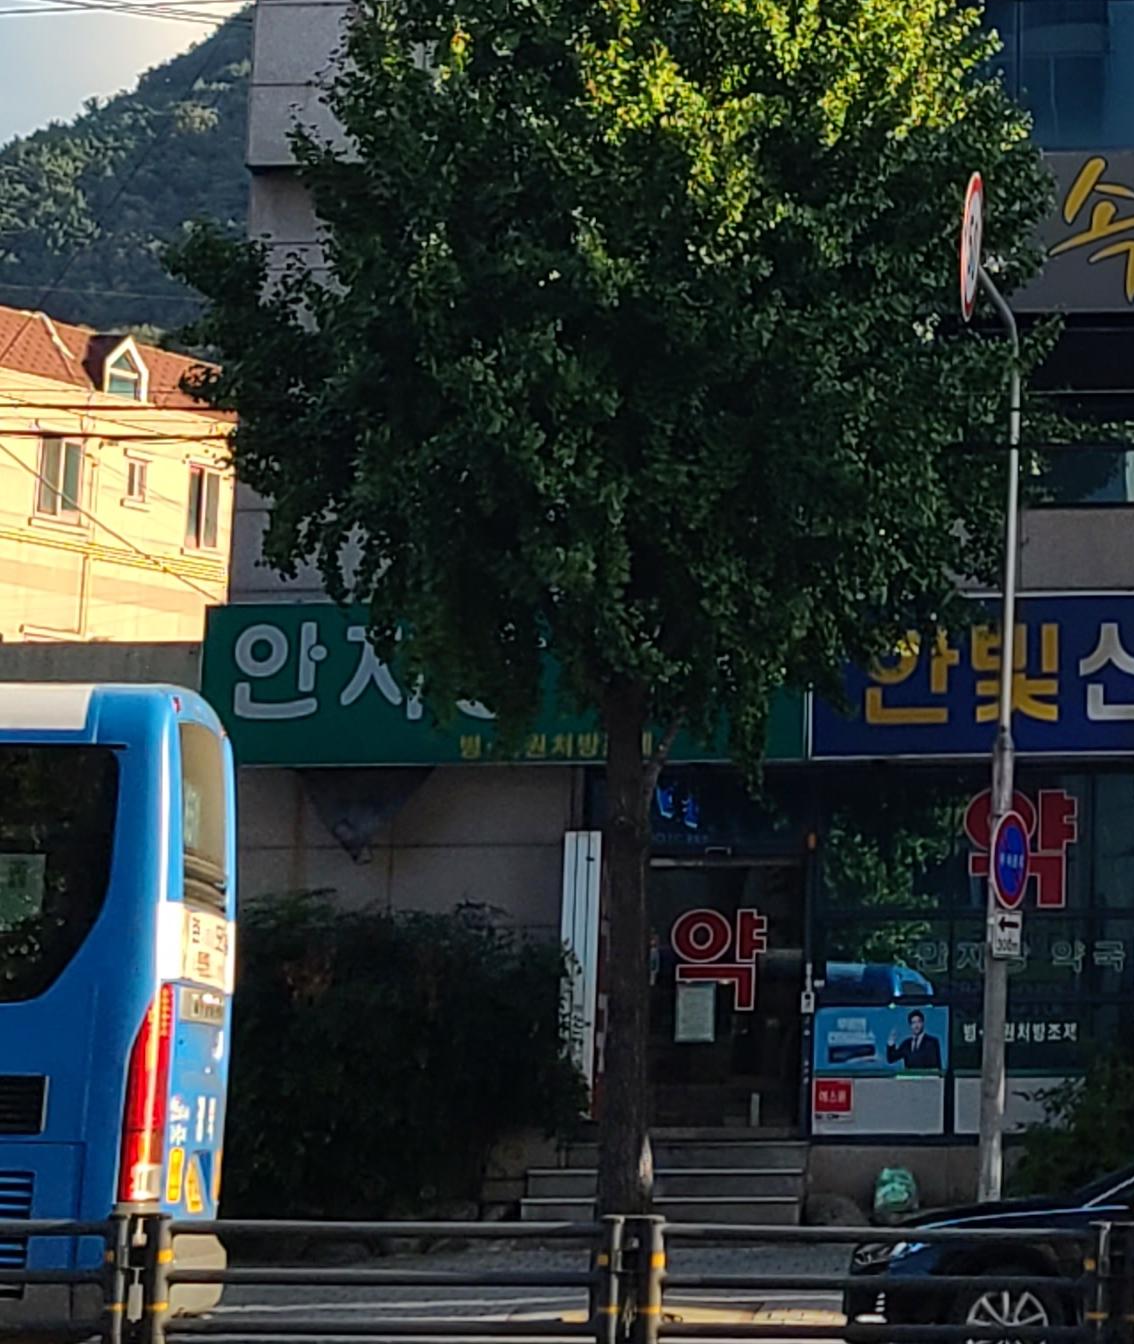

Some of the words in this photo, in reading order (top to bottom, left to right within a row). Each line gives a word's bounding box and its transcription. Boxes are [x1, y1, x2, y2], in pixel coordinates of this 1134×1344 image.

[963, 788, 1079, 909] 약
[671, 908, 768, 1011] 약
[1051, 938, 1127, 974] 약국
